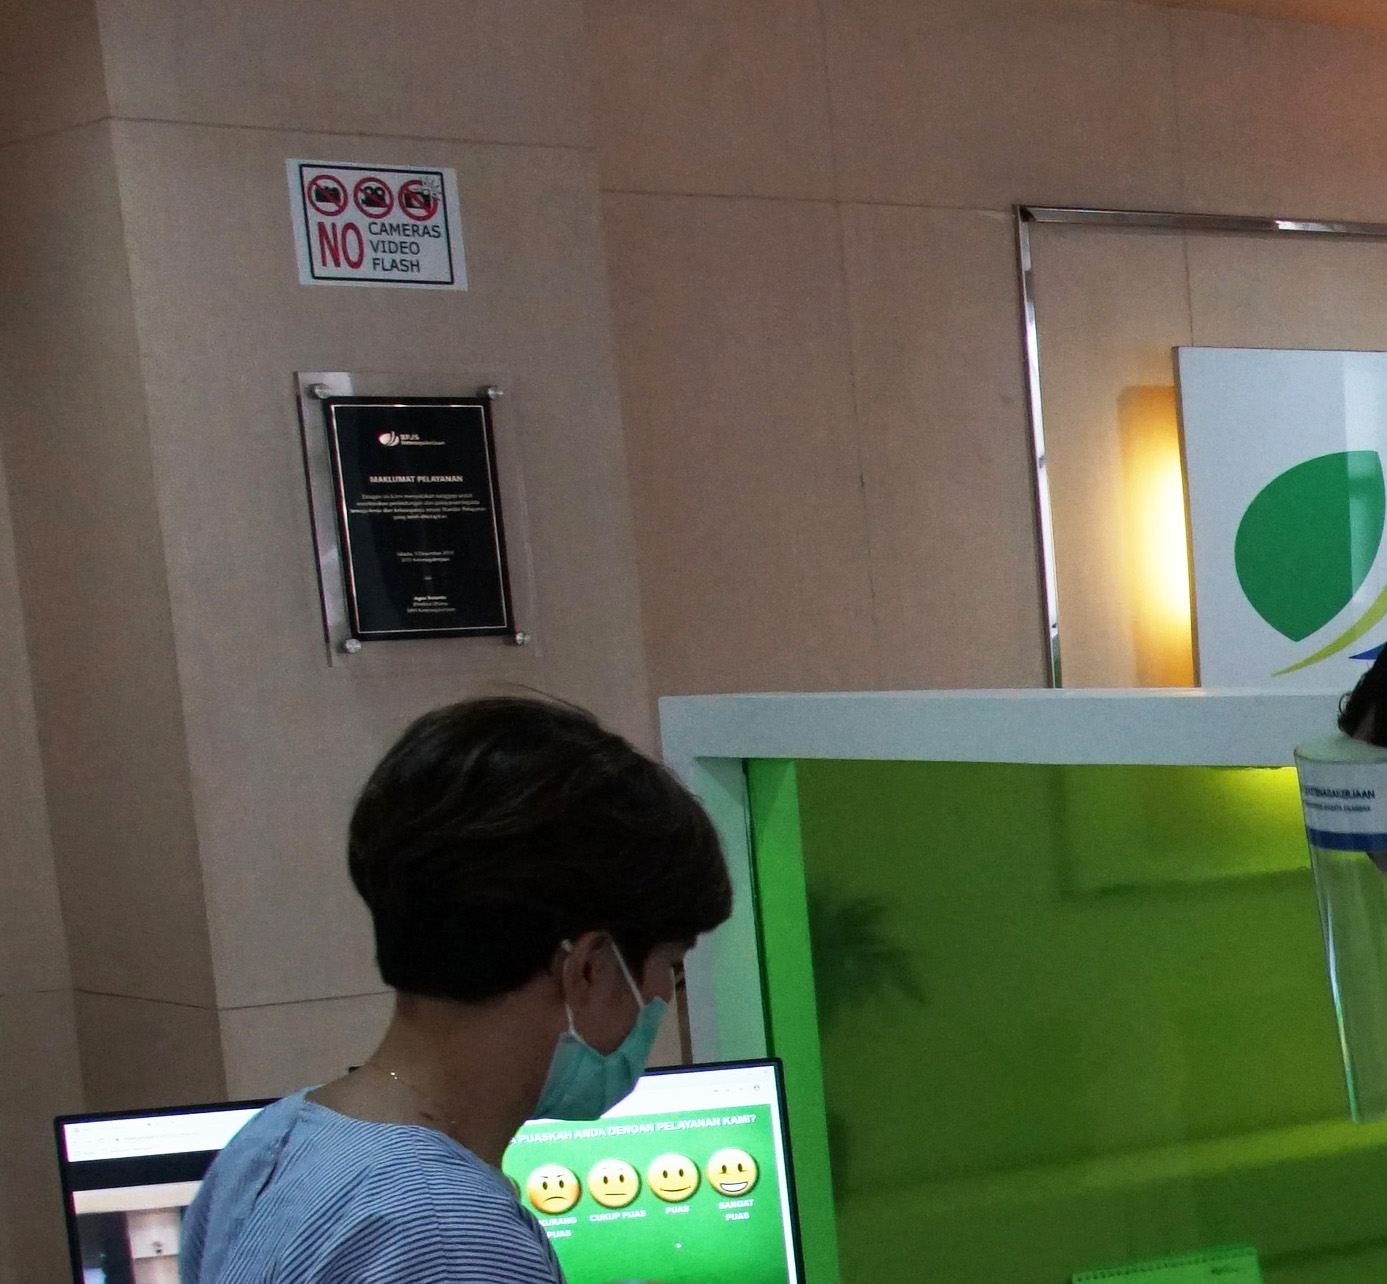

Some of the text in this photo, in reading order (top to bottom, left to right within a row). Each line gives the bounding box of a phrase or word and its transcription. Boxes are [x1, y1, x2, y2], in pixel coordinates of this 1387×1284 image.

[368, 221, 442, 239] CAMERAS
[317, 221, 365, 270] NO
[369, 239, 420, 256] VIDEO
[372, 257, 420, 273] FLASH
[518, 1130, 573, 1144] PUASKAH
[574, 1127, 606, 1139] ANDA
[608, 1122, 655, 1135] DENGAN
[656, 1116, 721, 1131] PELAYANAN
[722, 1113, 757, 1126] KAMI?
[665, 1205, 690, 1215] PUAS
[718, 1198, 755, 1210] SANGAT
[589, 1209, 647, 1222] CUKUP PUAS
[725, 1211, 750, 1222] PUAS
[547, 1229, 572, 1239] PUAS
